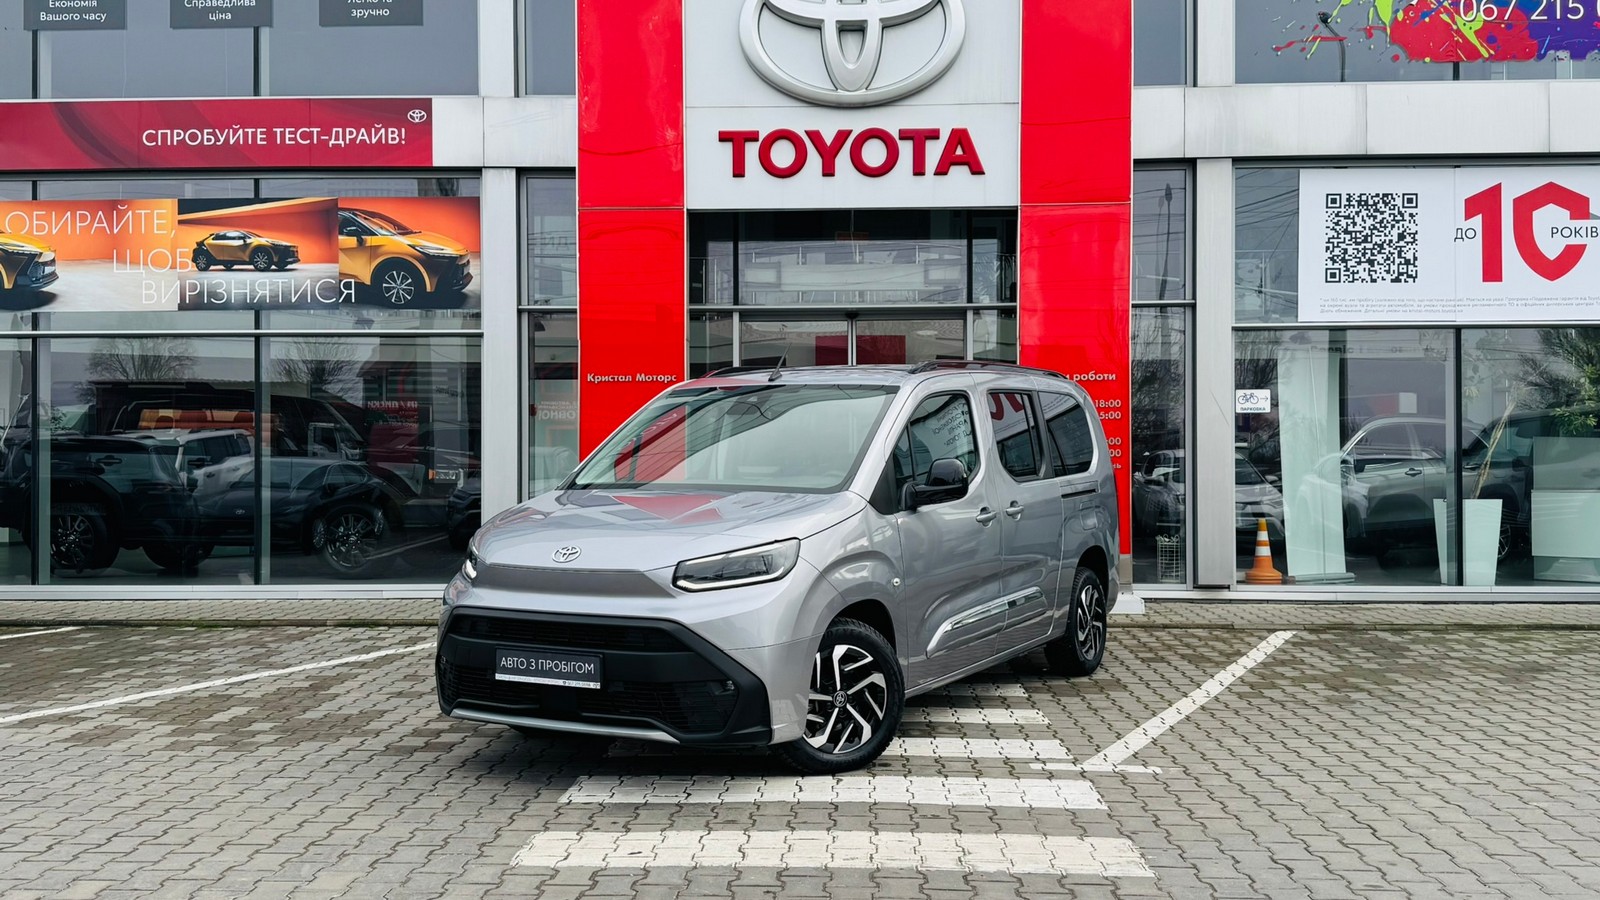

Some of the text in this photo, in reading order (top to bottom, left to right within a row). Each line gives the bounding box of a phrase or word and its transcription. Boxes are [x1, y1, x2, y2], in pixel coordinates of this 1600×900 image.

[49, 0, 98, 8] Економія
[184, 0, 256, 9] Справедлива
[208, 10, 232, 20] ціна
[351, 8, 390, 18] зручно
[1459, 0, 1517, 21] 067
[1530, 0, 1585, 20] 215
[40, 12, 107, 22] Вашого часу
[142, 123, 407, 148] СПРОБУЙТЕ ТЕСТ-ДРАЙВ!
[718, 127, 986, 179] TOYOTA
[4, 203, 177, 239] ОБИРАЙТЕ,
[1453, 226, 1477, 243] ДО
[1550, 226, 1600, 239] РОКІВ
[112, 247, 193, 278] ЩОБ
[141, 278, 357, 305] ВИРІЗНЯТИСЯ
[587, 373, 677, 384] Кристал Моторс
[1073, 370, 1117, 381] роботи
[1094, 399, 1122, 408] 18:00
[1099, 411, 1122, 420] 5:00
[500, 657, 527, 669] АВТО
[538, 660, 594, 674] ПРОБІГОМ
